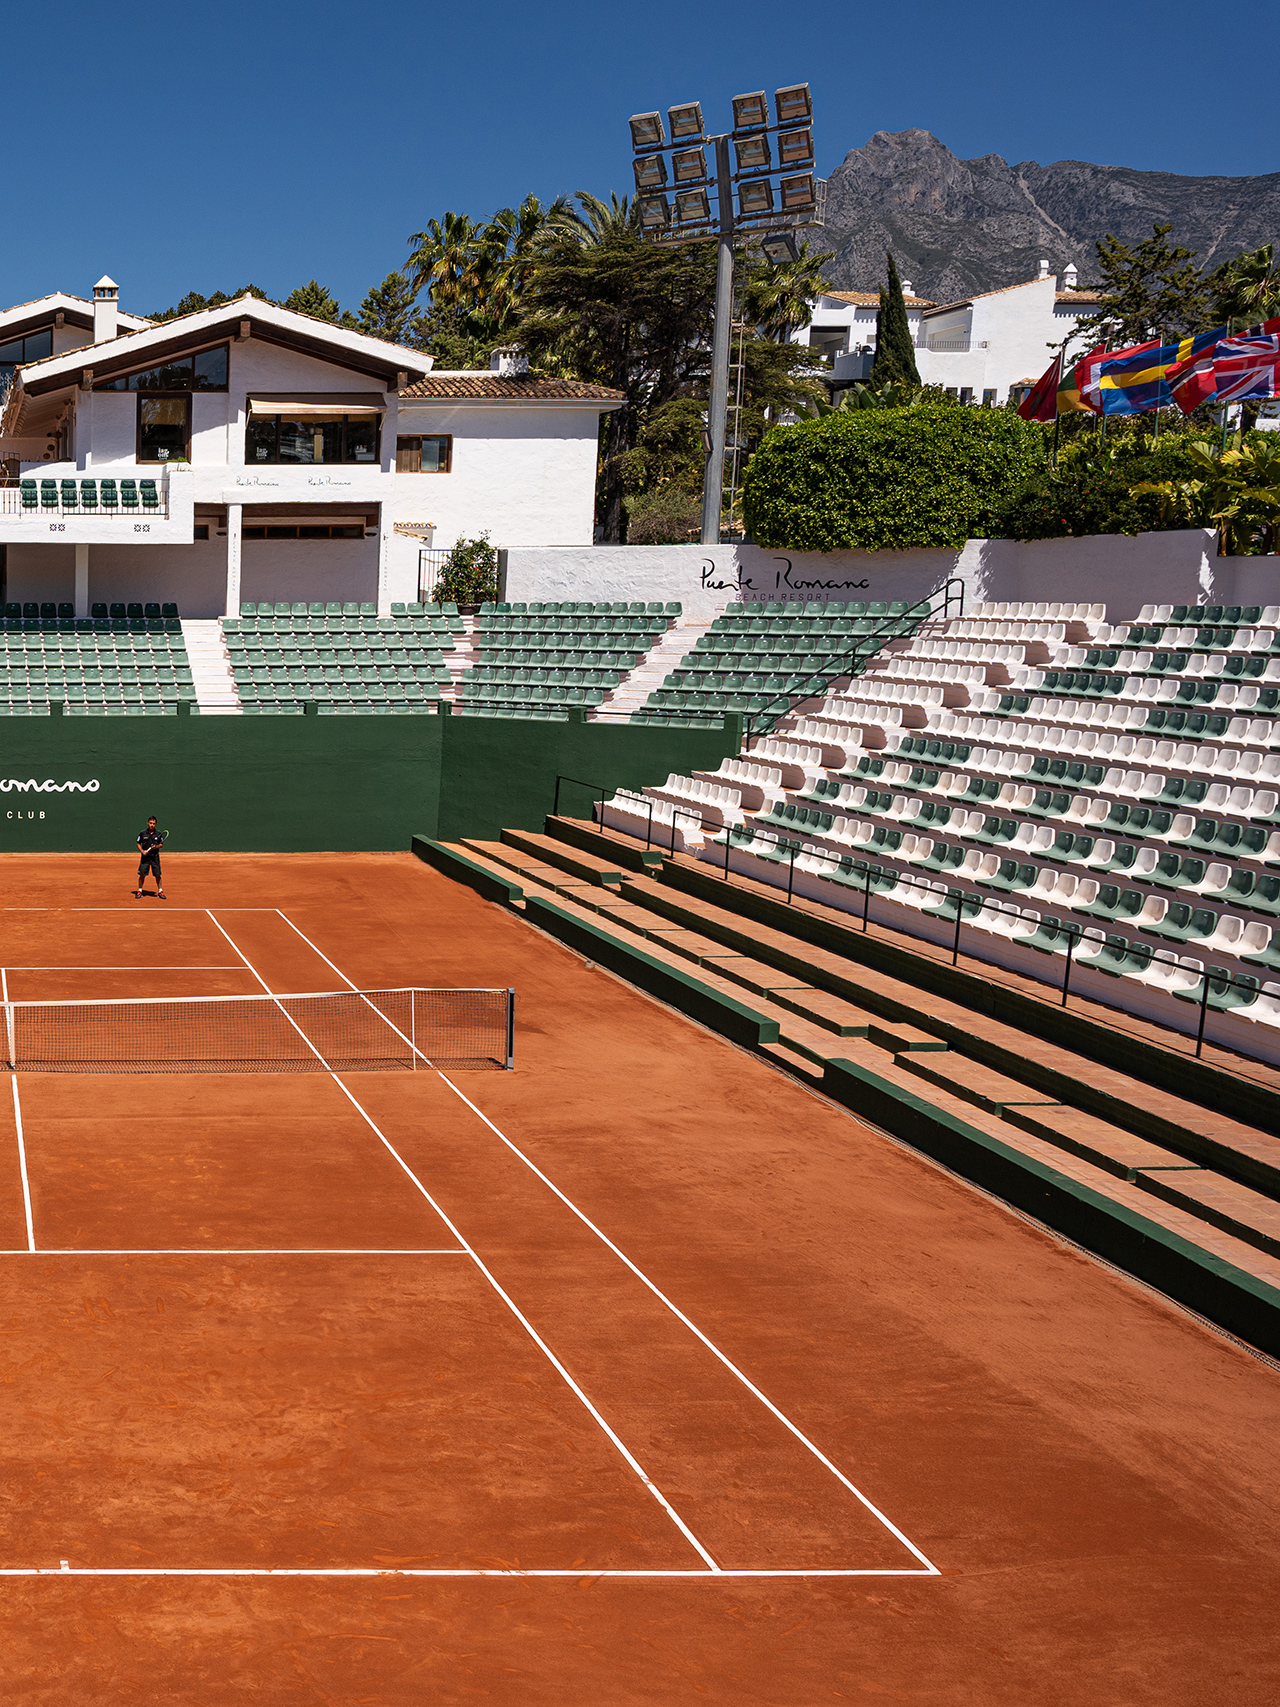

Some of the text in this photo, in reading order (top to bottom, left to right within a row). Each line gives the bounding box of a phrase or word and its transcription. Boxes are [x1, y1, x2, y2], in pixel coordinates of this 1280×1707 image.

[700, 556, 870, 591] Puente Romano
[735, 593, 831, 601] BEACH RESORT
[6, 810, 46, 819] CLUB
